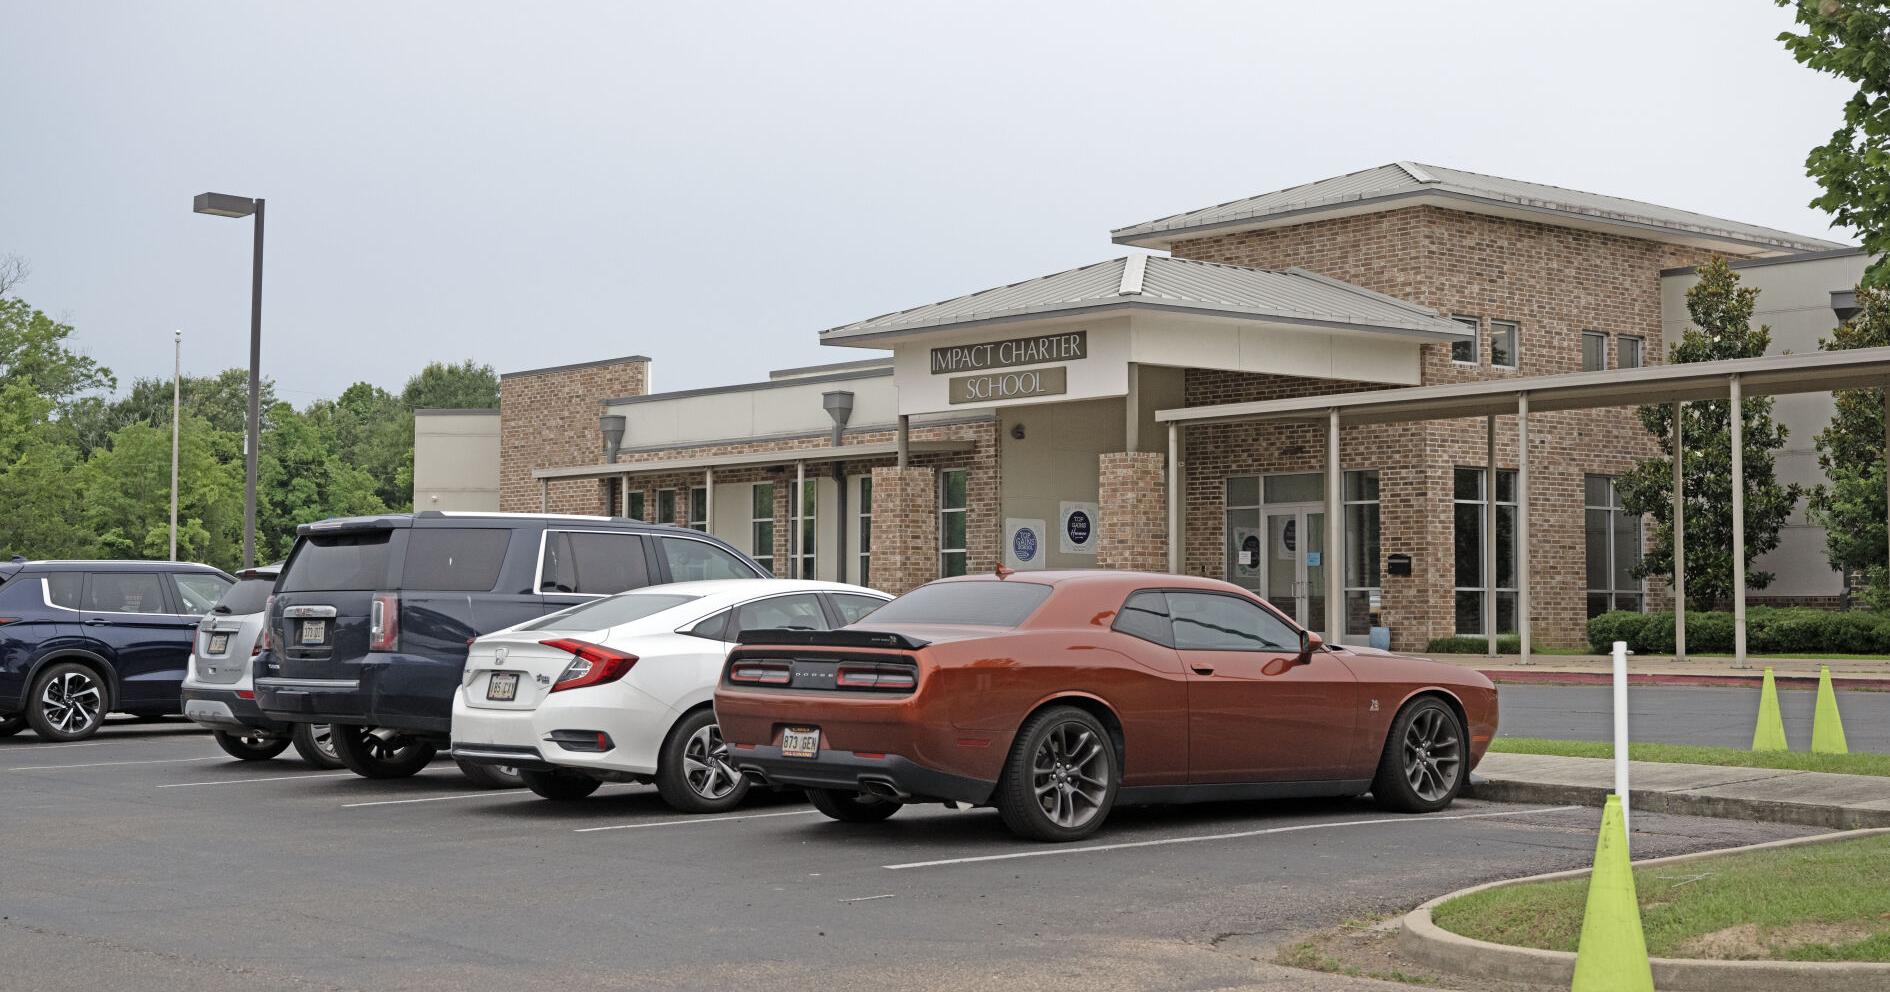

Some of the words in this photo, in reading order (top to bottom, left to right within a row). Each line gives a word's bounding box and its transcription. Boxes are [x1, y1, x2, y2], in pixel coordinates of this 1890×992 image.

[932, 344, 995, 371] IMPACT
[1000, 334, 1081, 364] CHARTER
[966, 372, 1045, 399] SCHOOL
[783, 735, 798, 749] 873
[802, 736, 817, 750] GEN
